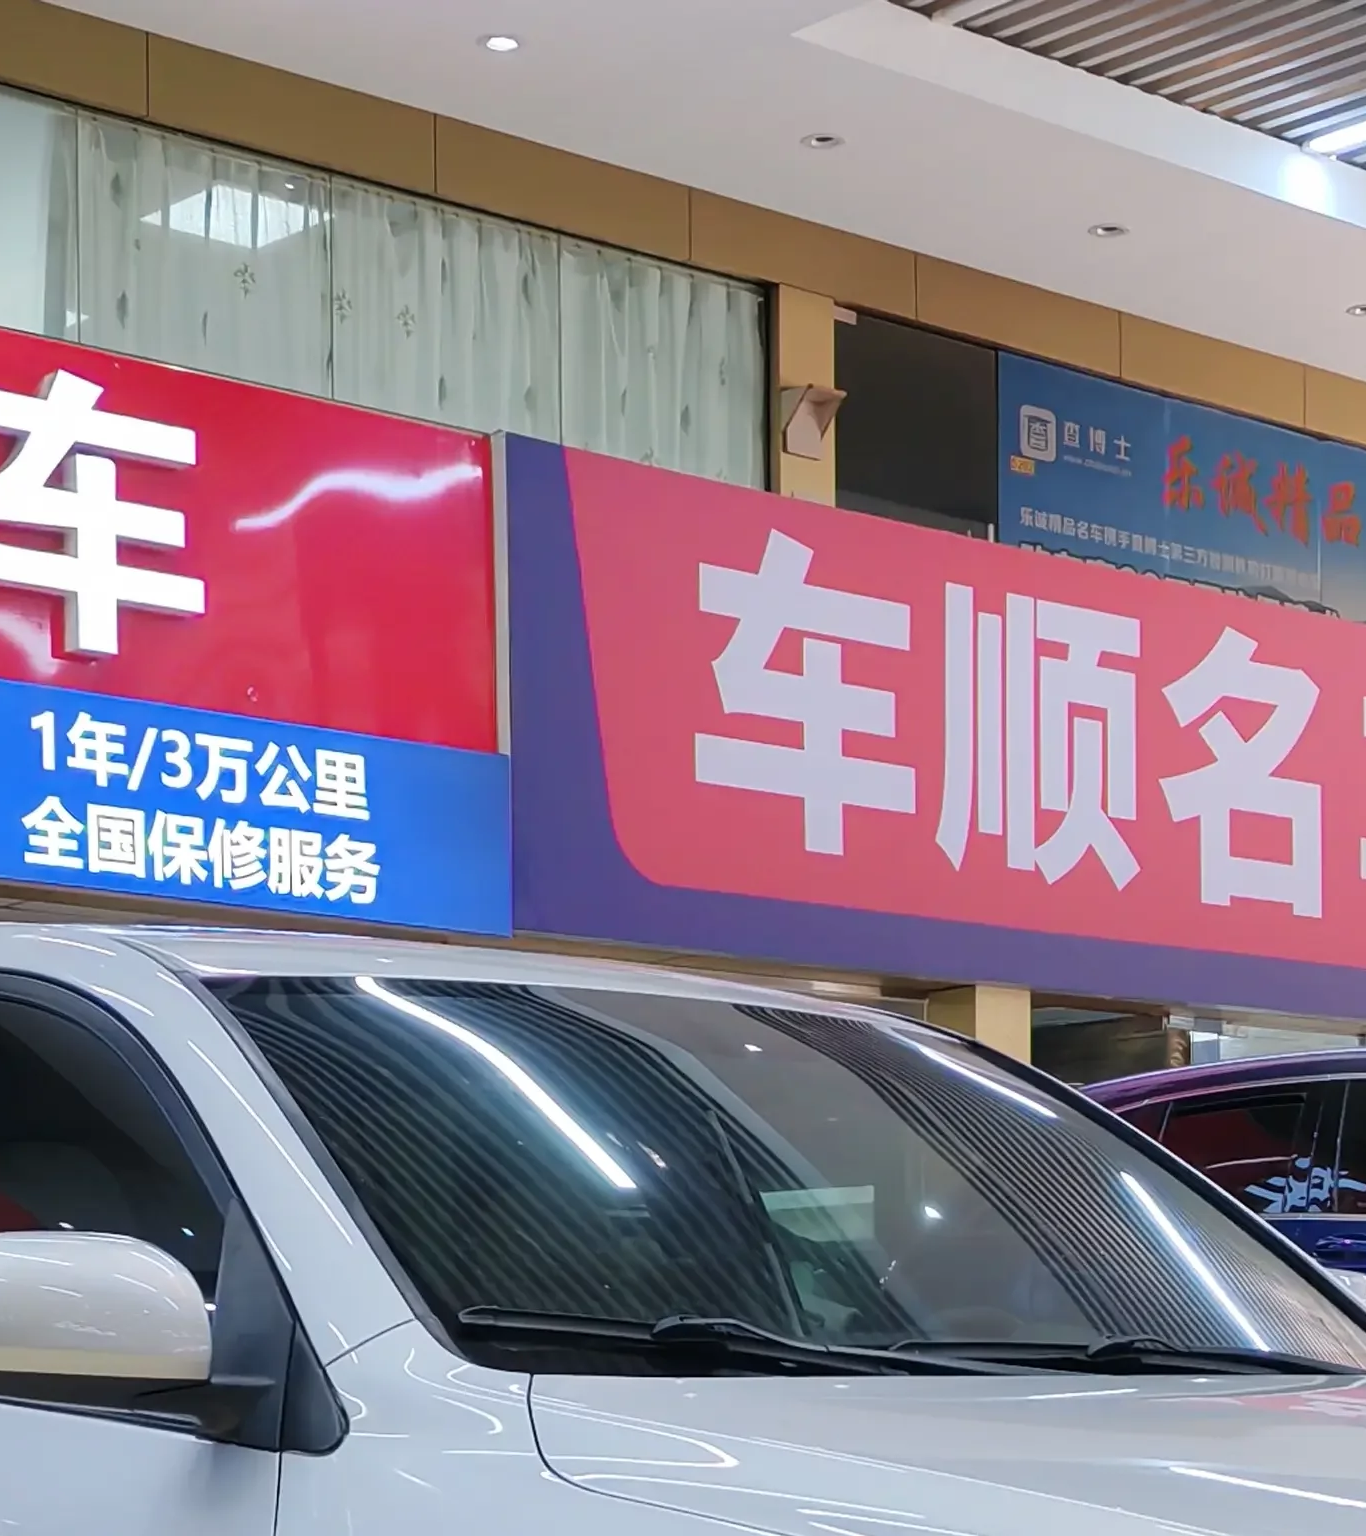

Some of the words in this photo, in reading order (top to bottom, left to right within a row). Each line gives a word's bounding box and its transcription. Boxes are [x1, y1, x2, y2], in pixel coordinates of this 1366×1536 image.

[29, 710, 371, 823] 1年/3万公里
[22, 797, 380, 905] 全国保修服务
